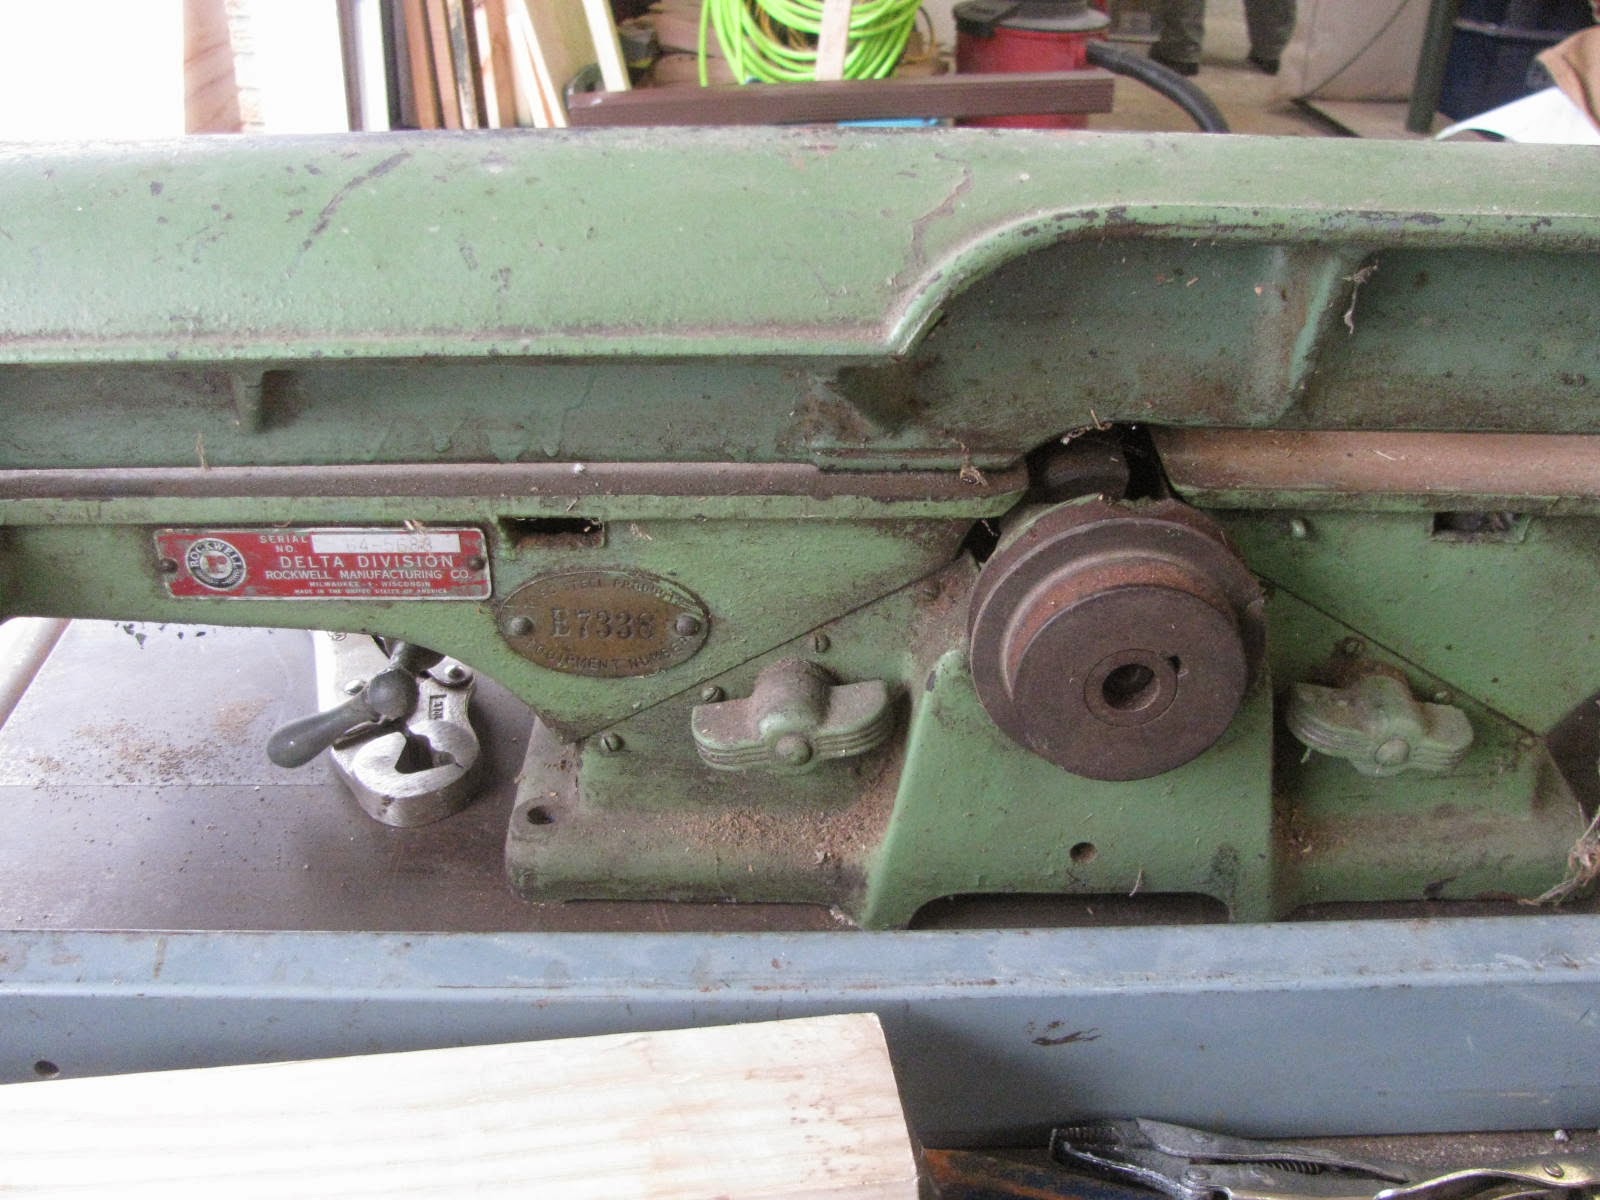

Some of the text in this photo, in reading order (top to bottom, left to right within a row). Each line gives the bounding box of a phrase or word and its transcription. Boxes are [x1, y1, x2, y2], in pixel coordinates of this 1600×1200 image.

[259, 535, 308, 544] SERIAL
[189, 541, 242, 567] ROCKWELL
[280, 555, 453, 568] DELTA DIVISION
[264, 569, 473, 580] ROCKWELL MANUFACTURING CO.
